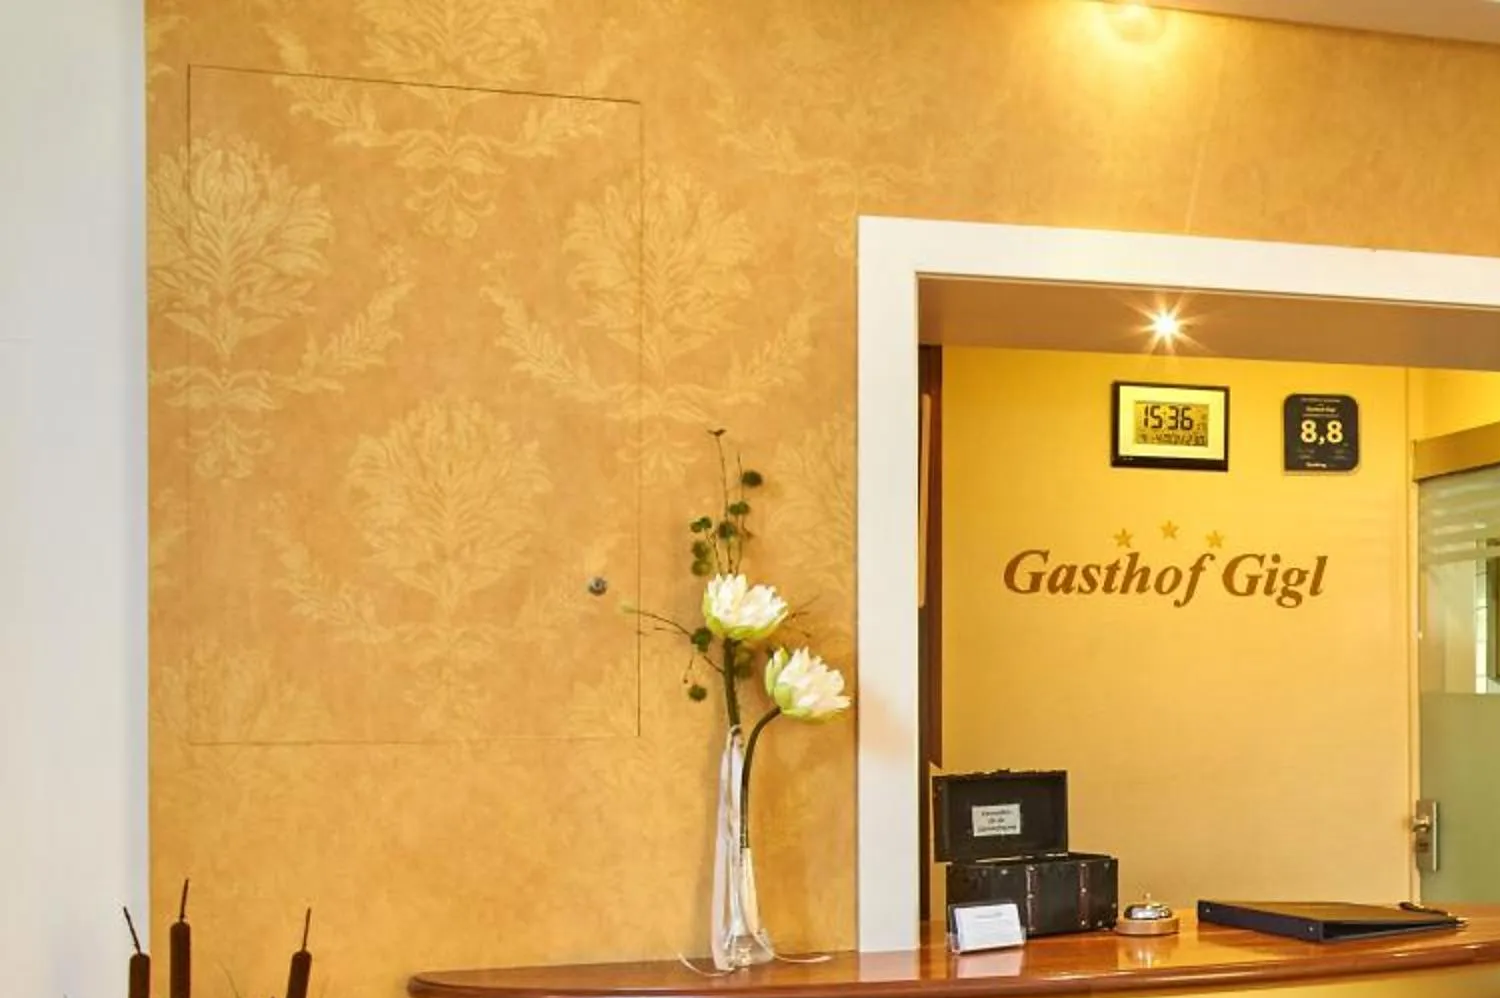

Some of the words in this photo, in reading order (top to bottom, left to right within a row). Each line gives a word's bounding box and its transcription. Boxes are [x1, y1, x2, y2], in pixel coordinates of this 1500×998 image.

[1301, 420, 1343, 445] 8,8
[1003, 549, 1216, 608] Gasthof
[1221, 553, 1328, 609] Gigl
